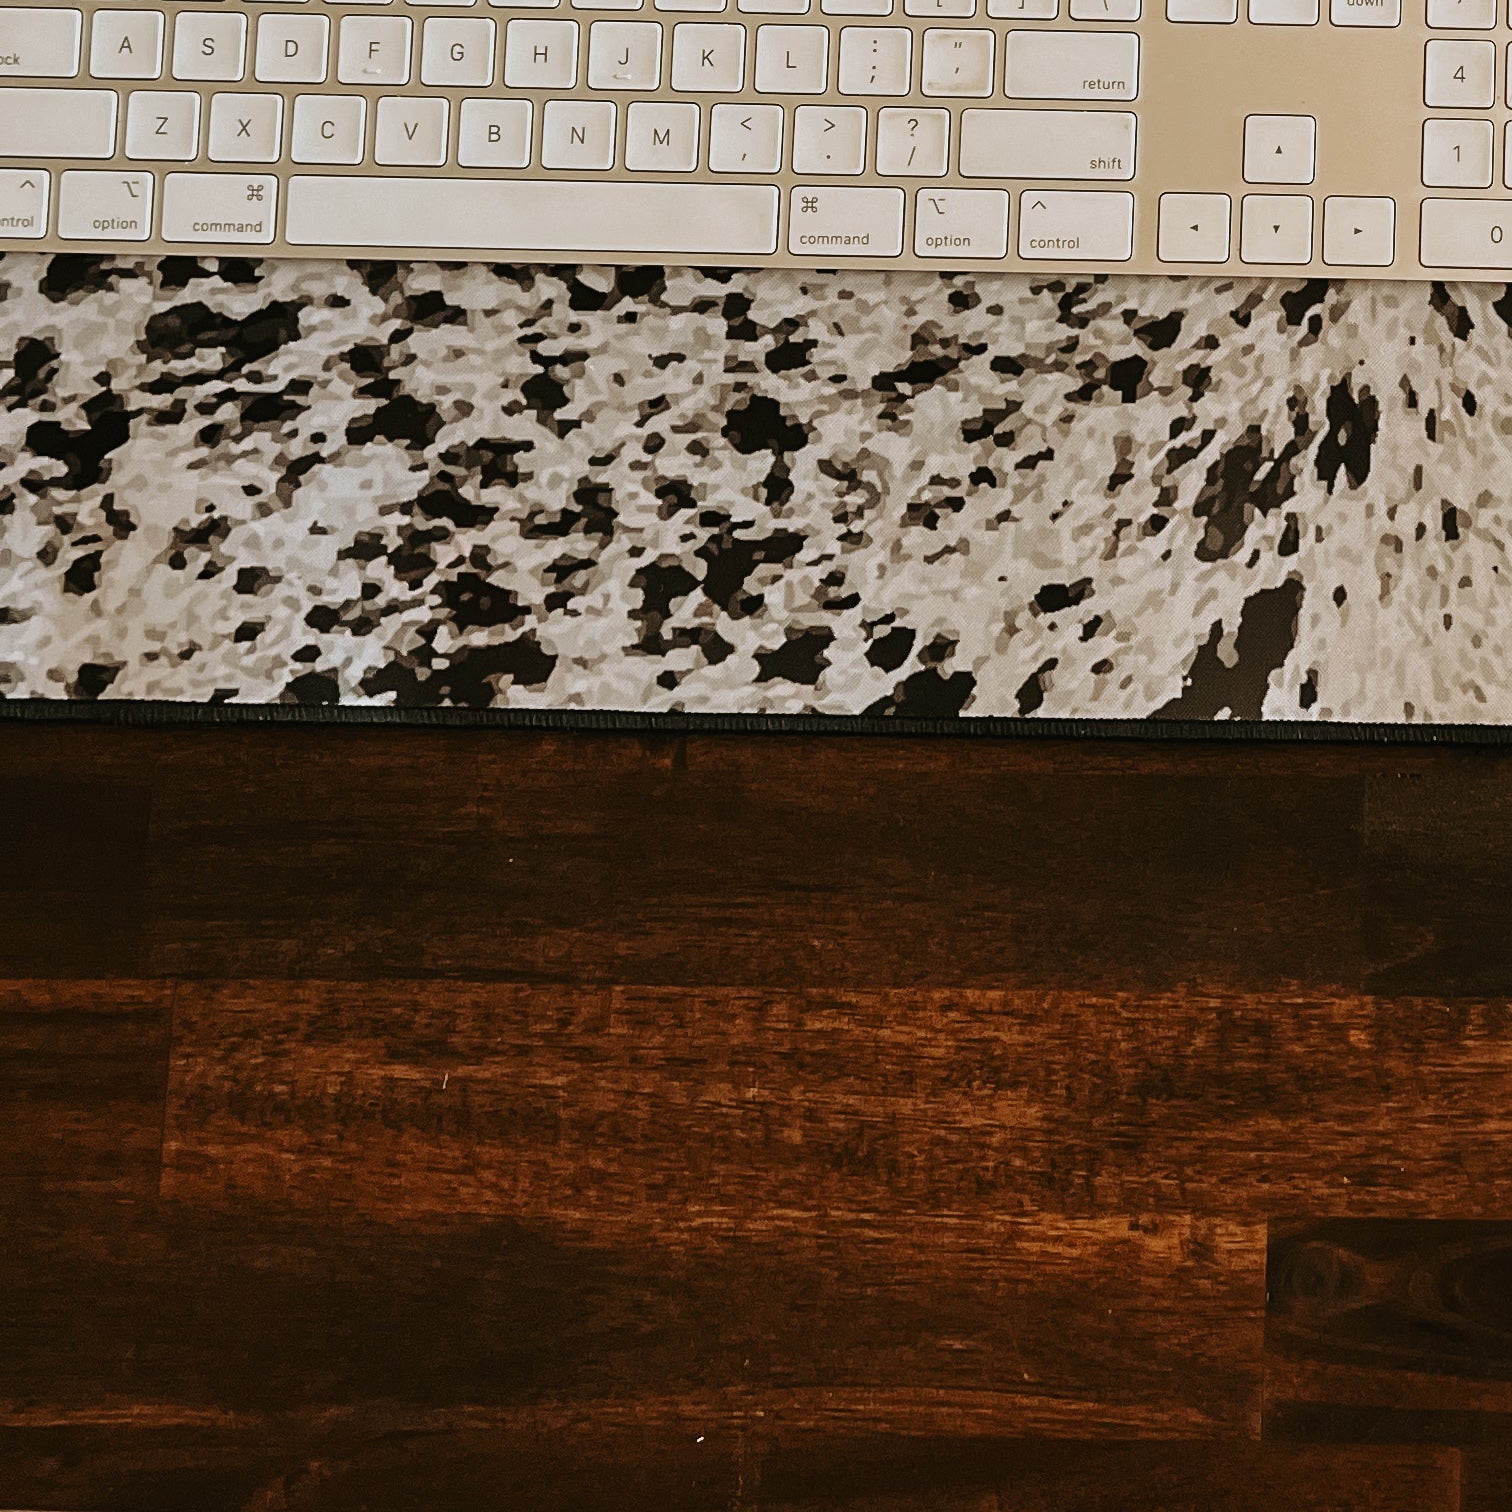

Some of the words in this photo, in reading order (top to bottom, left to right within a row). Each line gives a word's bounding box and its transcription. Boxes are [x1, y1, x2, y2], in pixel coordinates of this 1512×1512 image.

[118, 35, 133, 54] A
[201, 37, 215, 56] S
[284, 39, 299, 58] D
[368, 41, 381, 60] F
[450, 42, 465, 62] G
[533, 45, 548, 64] H
[617, 47, 630, 66] J
[701, 49, 715, 67] K
[785, 50, 798, 69] L
[1453, 65, 1467, 83] 4
[1082, 78, 1126, 90] return
[155, 116, 169, 135] Z
[236, 118, 252, 138] X
[320, 120, 335, 140] C
[403, 121, 419, 141] V
[487, 124, 501, 143] B
[570, 126, 586, 145] N
[652, 128, 670, 147] M
[1089, 157, 1123, 170] shift
[1452, 145, 1461, 163] 1
[92, 217, 138, 232] option
[192, 220, 263, 233] command
[799, 233, 870, 246] command
[925, 235, 971, 249] option
[1029, 236, 1080, 249] control
